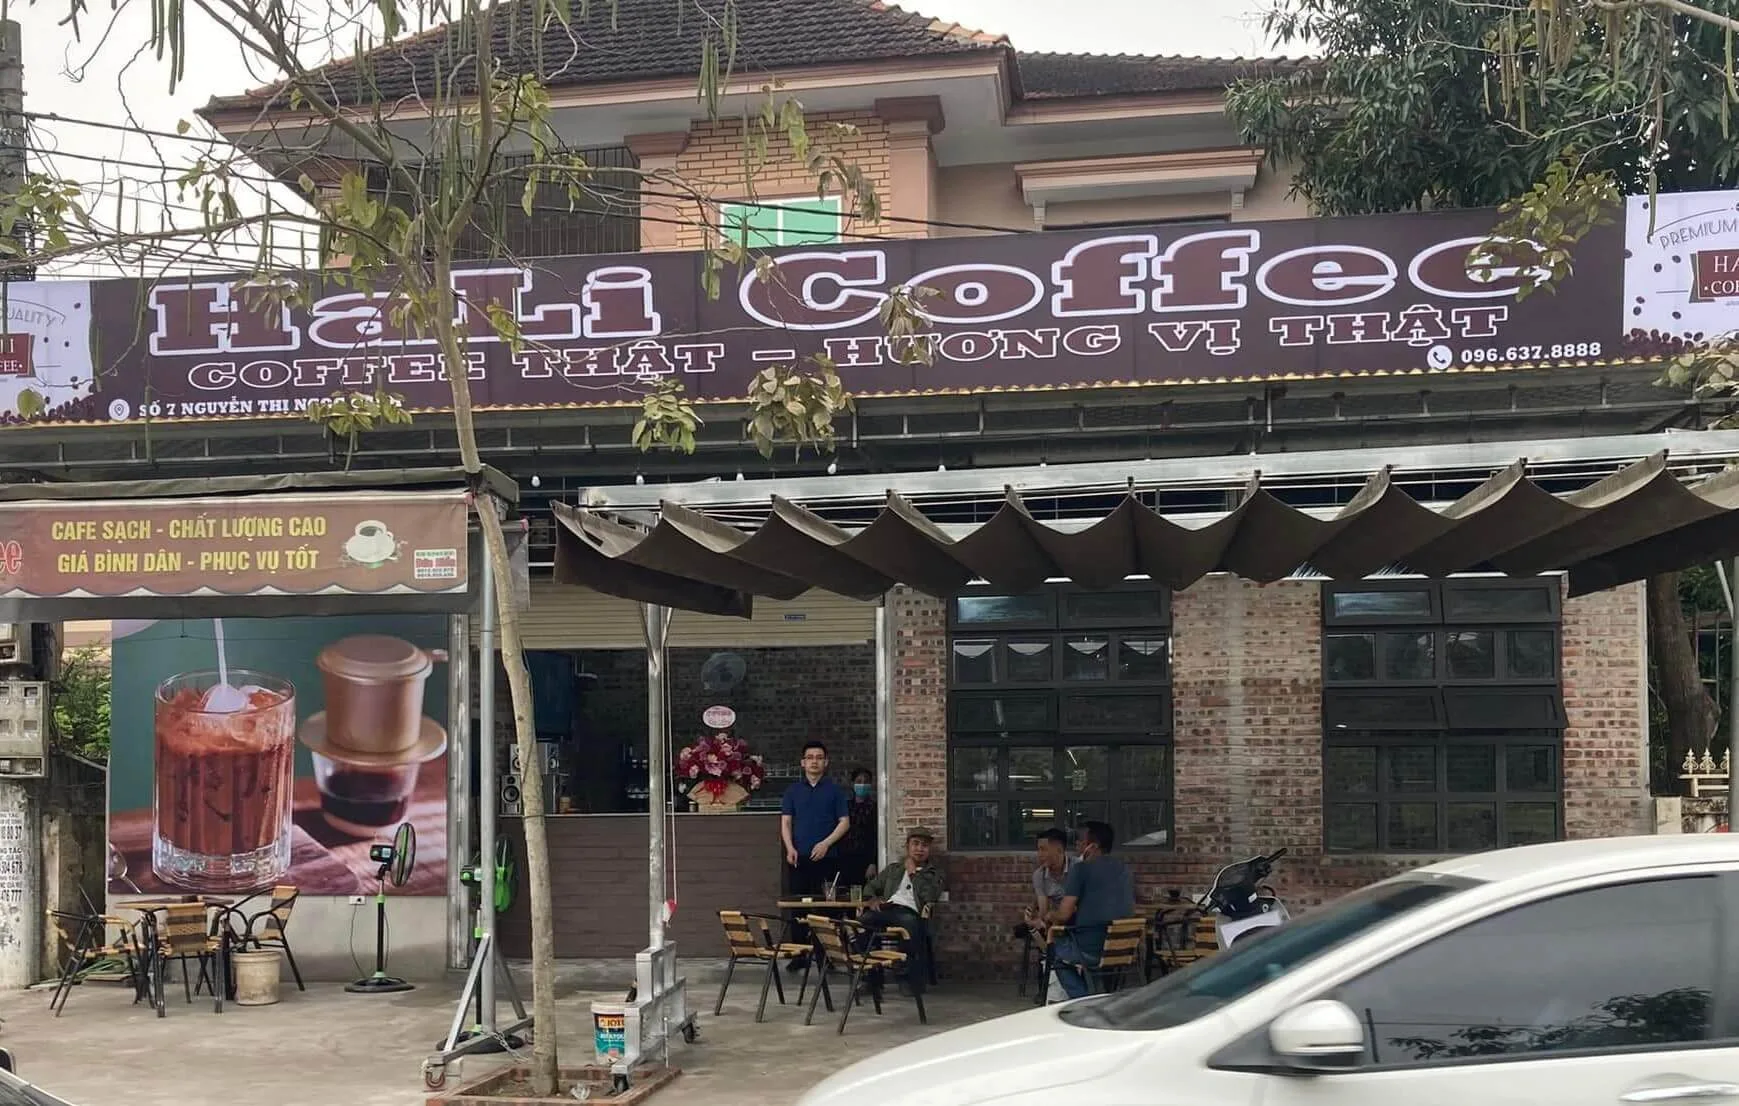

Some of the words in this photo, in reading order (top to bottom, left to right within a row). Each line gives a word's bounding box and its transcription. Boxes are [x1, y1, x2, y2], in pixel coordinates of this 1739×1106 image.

[1659, 218, 1737, 249] PREMIUM
[739, 229, 1553, 331] Coffee
[7, 305, 56, 327] UALITY
[187, 351, 486, 391] COFFEE
[511, 339, 725, 380] THẬT
[823, 325, 1122, 367] HƯƠNG
[1149, 319, 1241, 356] VỊ
[1269, 304, 1508, 347] THẬT
[1461, 342, 1602, 363] 096.637.8888
[138, 400, 161, 416] SỐ
[166, 403, 176, 416] 7
[181, 396, 253, 414] NGUYỄN
[258, 399, 289, 414] THỊ
[51, 521, 97, 540] CAFE
[102, 519, 151, 543] SẠCH
[169, 512, 217, 539] CHẤT
[222, 515, 283, 541] LƯỢNG
[288, 516, 326, 537] CAO
[57, 549, 89, 573] GIÁ
[94, 548, 138, 572] BÌNH
[143, 548, 181, 572] DÂN
[200, 550, 250, 575] PHỤC
[256, 550, 280, 575] VỤ
[285, 543, 320, 570] TỐT
